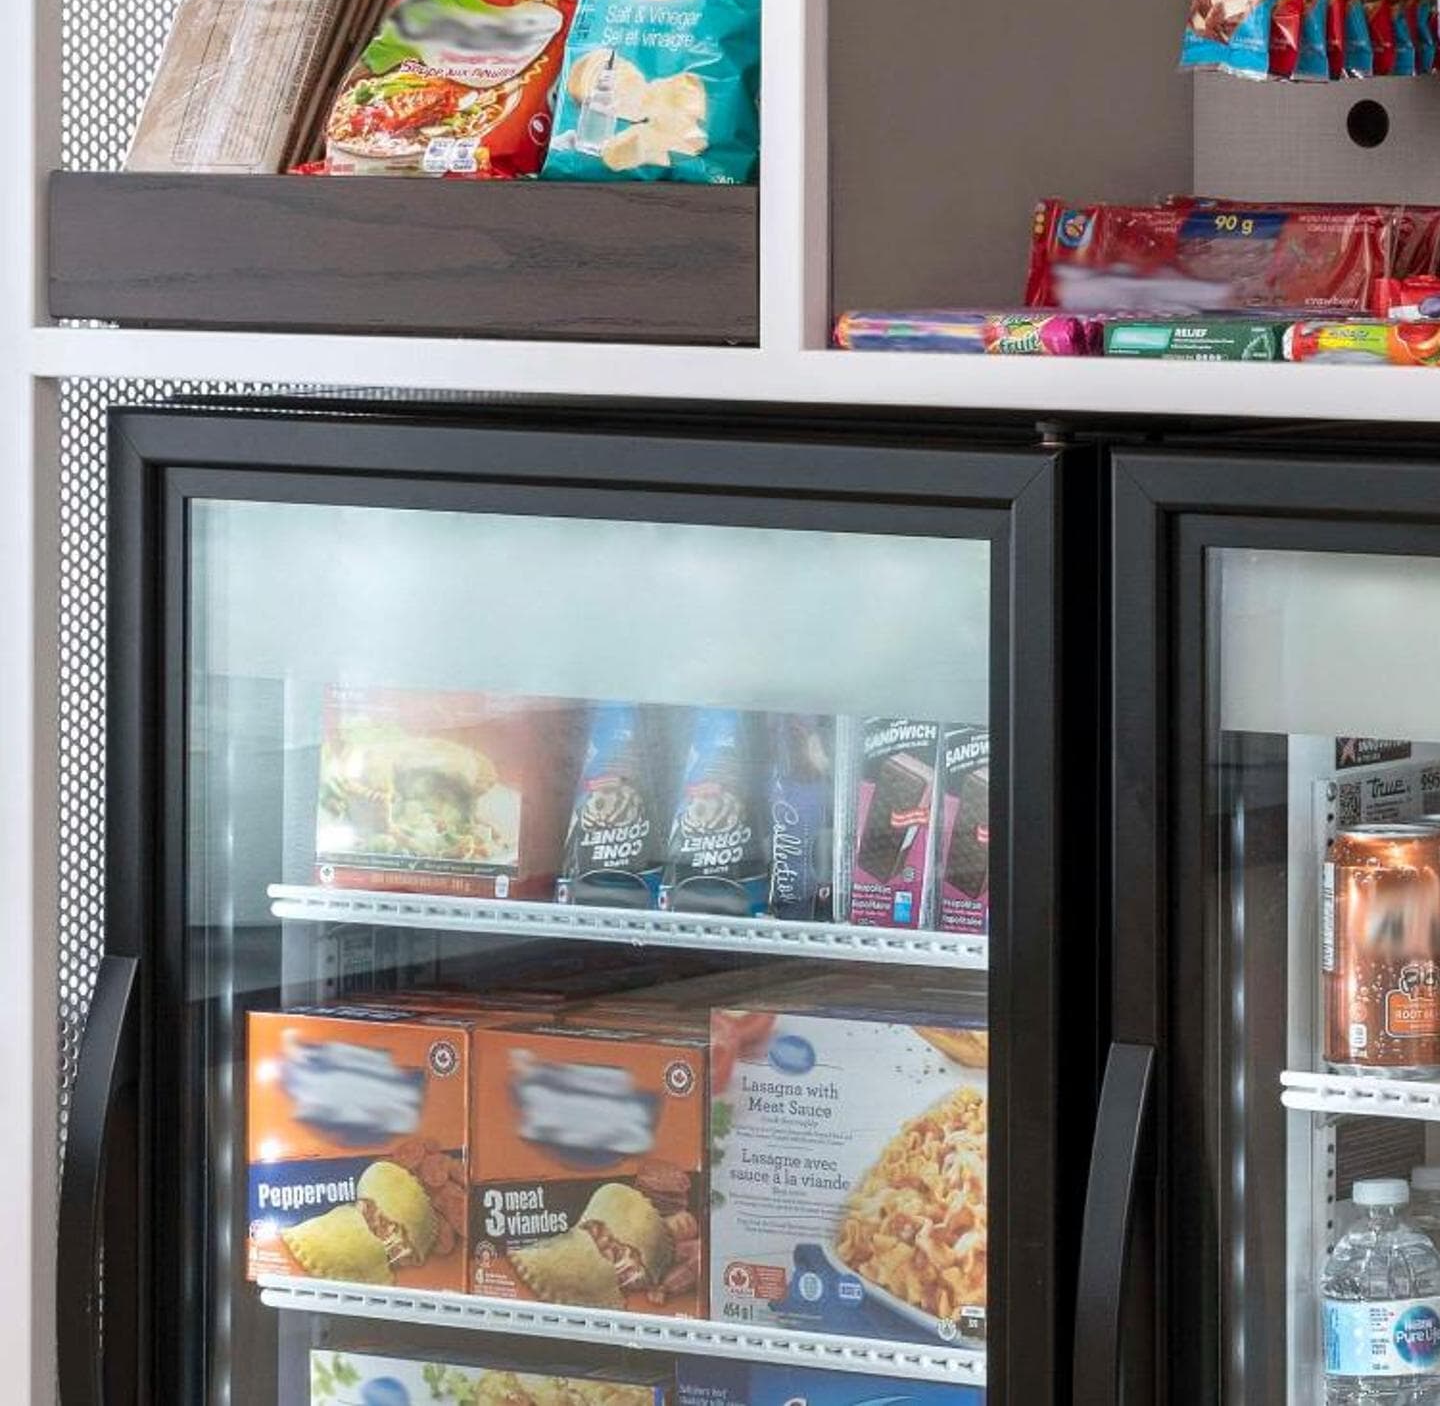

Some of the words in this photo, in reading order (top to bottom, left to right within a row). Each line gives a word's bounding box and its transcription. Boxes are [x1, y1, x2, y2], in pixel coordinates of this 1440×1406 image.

[605, 5, 632, 24] Salt
[1215, 215, 1236, 230] 90
[1242, 218, 1254, 234] g
[1174, 328, 1207, 337] RELIEF
[864, 725, 937, 753] SANDWICH
[592, 840, 643, 861] CONE
[692, 847, 743, 867] CONE
[806, 1084, 838, 1099] with
[748, 1096, 784, 1113] Meat
[789, 1101, 832, 1118] Sauce
[803, 1158, 837, 1171] avec
[802, 1174, 850, 1190] viande
[258, 1177, 355, 1210] Pepperoni
[504, 1187, 544, 1210] meat
[483, 1189, 505, 1237] 3
[507, 1210, 569, 1235] viandes
